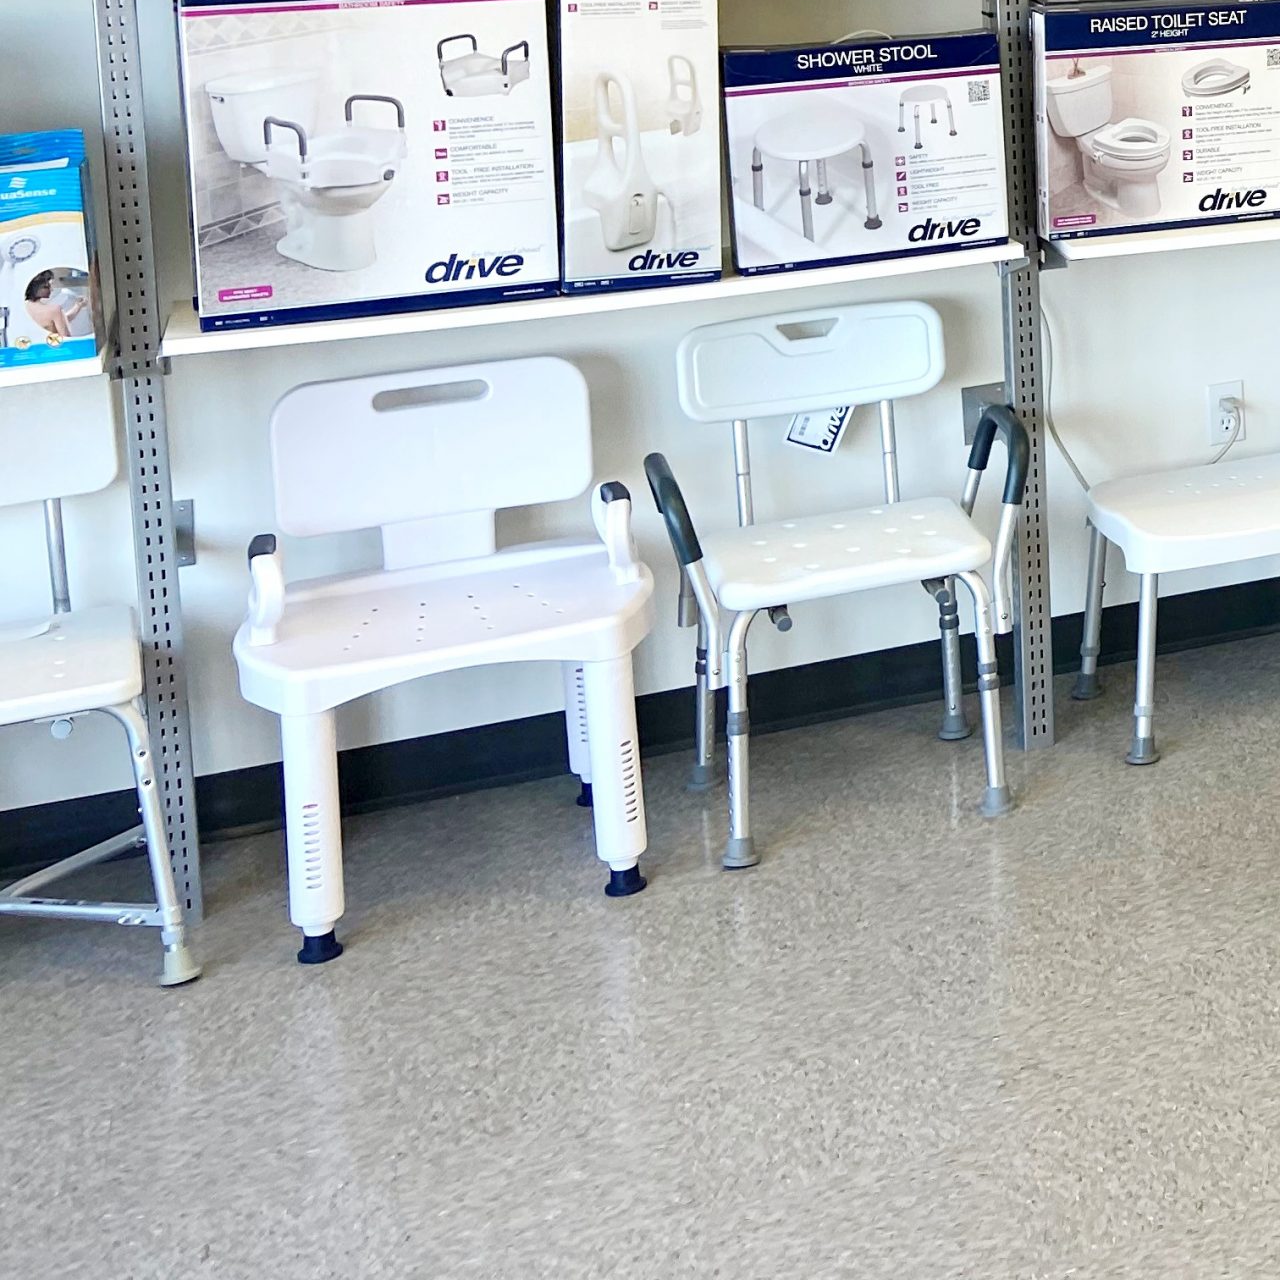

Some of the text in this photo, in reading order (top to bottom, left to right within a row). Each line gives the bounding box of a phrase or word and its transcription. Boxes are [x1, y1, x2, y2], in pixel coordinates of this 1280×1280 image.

[1090, 10, 1247, 33] RAISED TOILET SEAT
[1160, 29, 1189, 38] HEIGHT
[798, 44, 938, 70] SHOWER STOOL
[853, 64, 883, 74] WHITE
[1199, 188, 1266, 212] drive
[908, 218, 981, 242] drive
[425, 253, 524, 284] drive
[628, 250, 699, 271] drive
